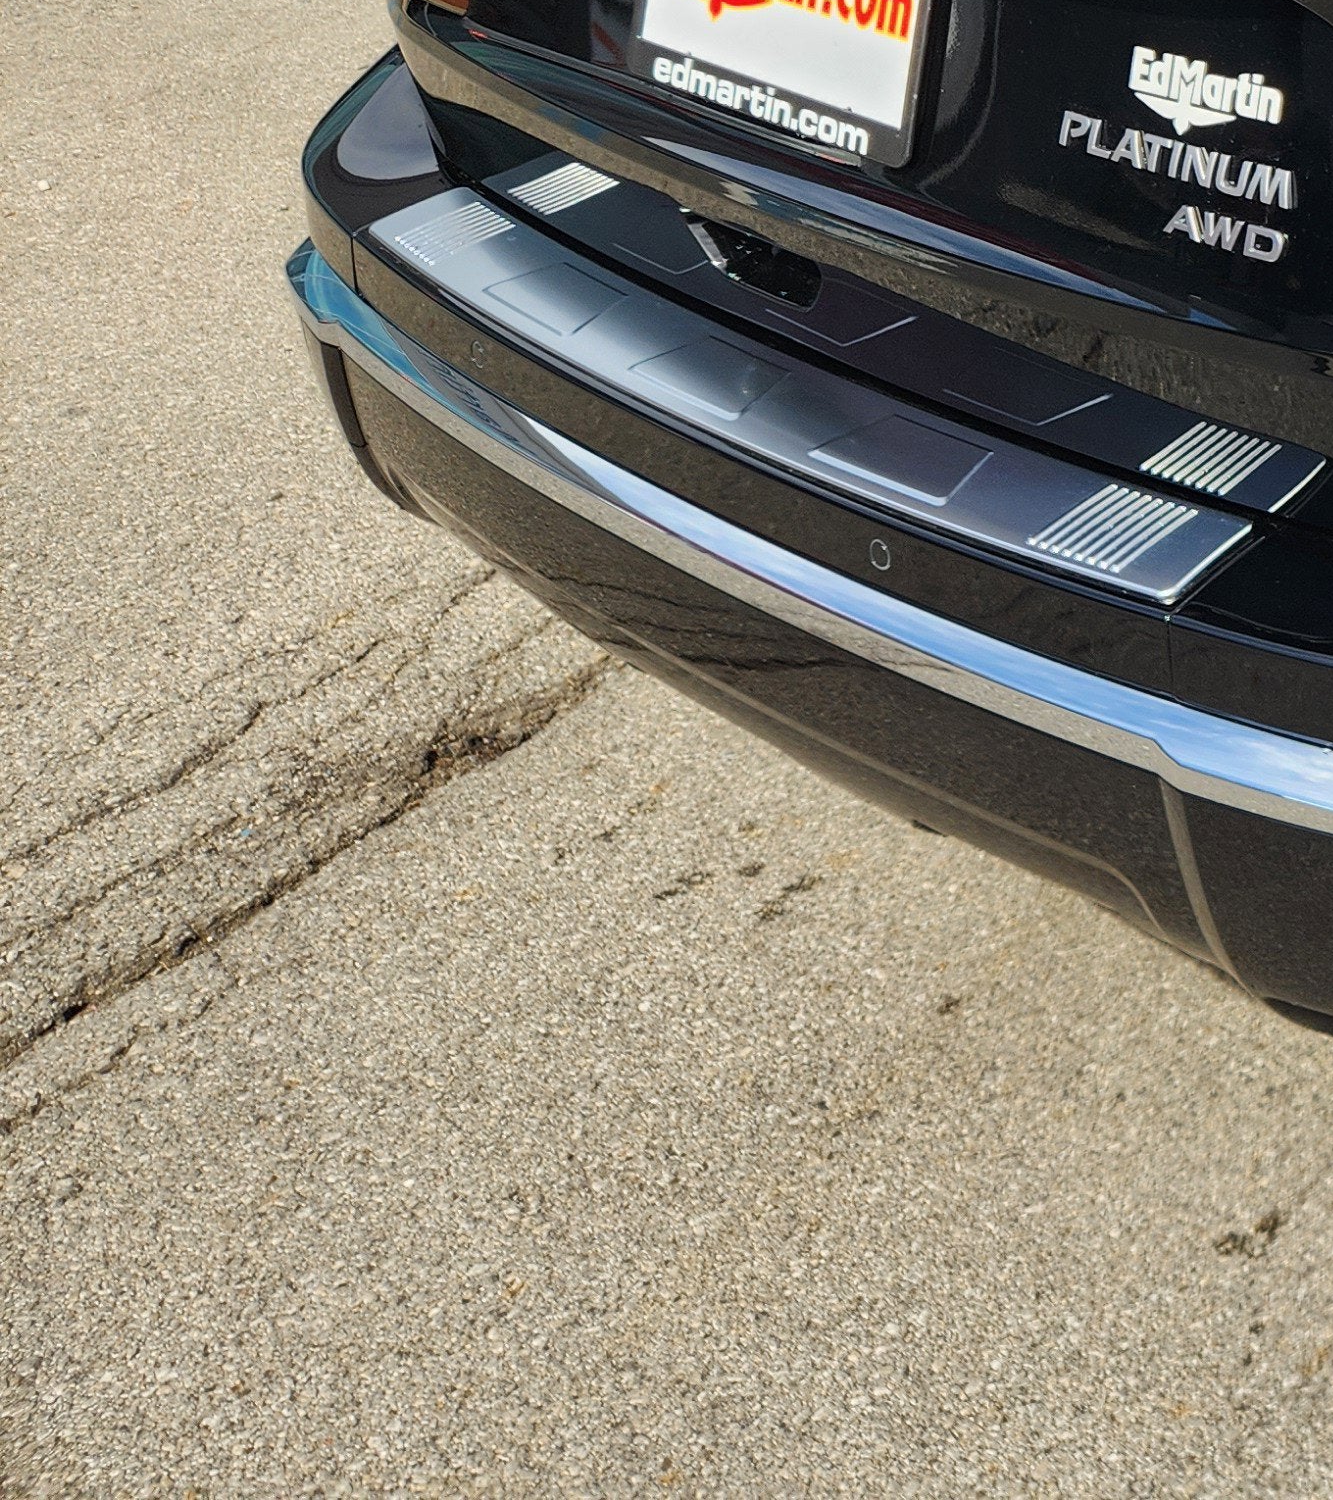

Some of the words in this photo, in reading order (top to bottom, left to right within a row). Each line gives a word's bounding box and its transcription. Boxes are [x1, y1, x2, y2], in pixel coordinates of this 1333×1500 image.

[651, 52, 869, 155] edmartin.com
[1058, 110, 1297, 210] PLATINUM
[1162, 204, 1289, 263] AWD
